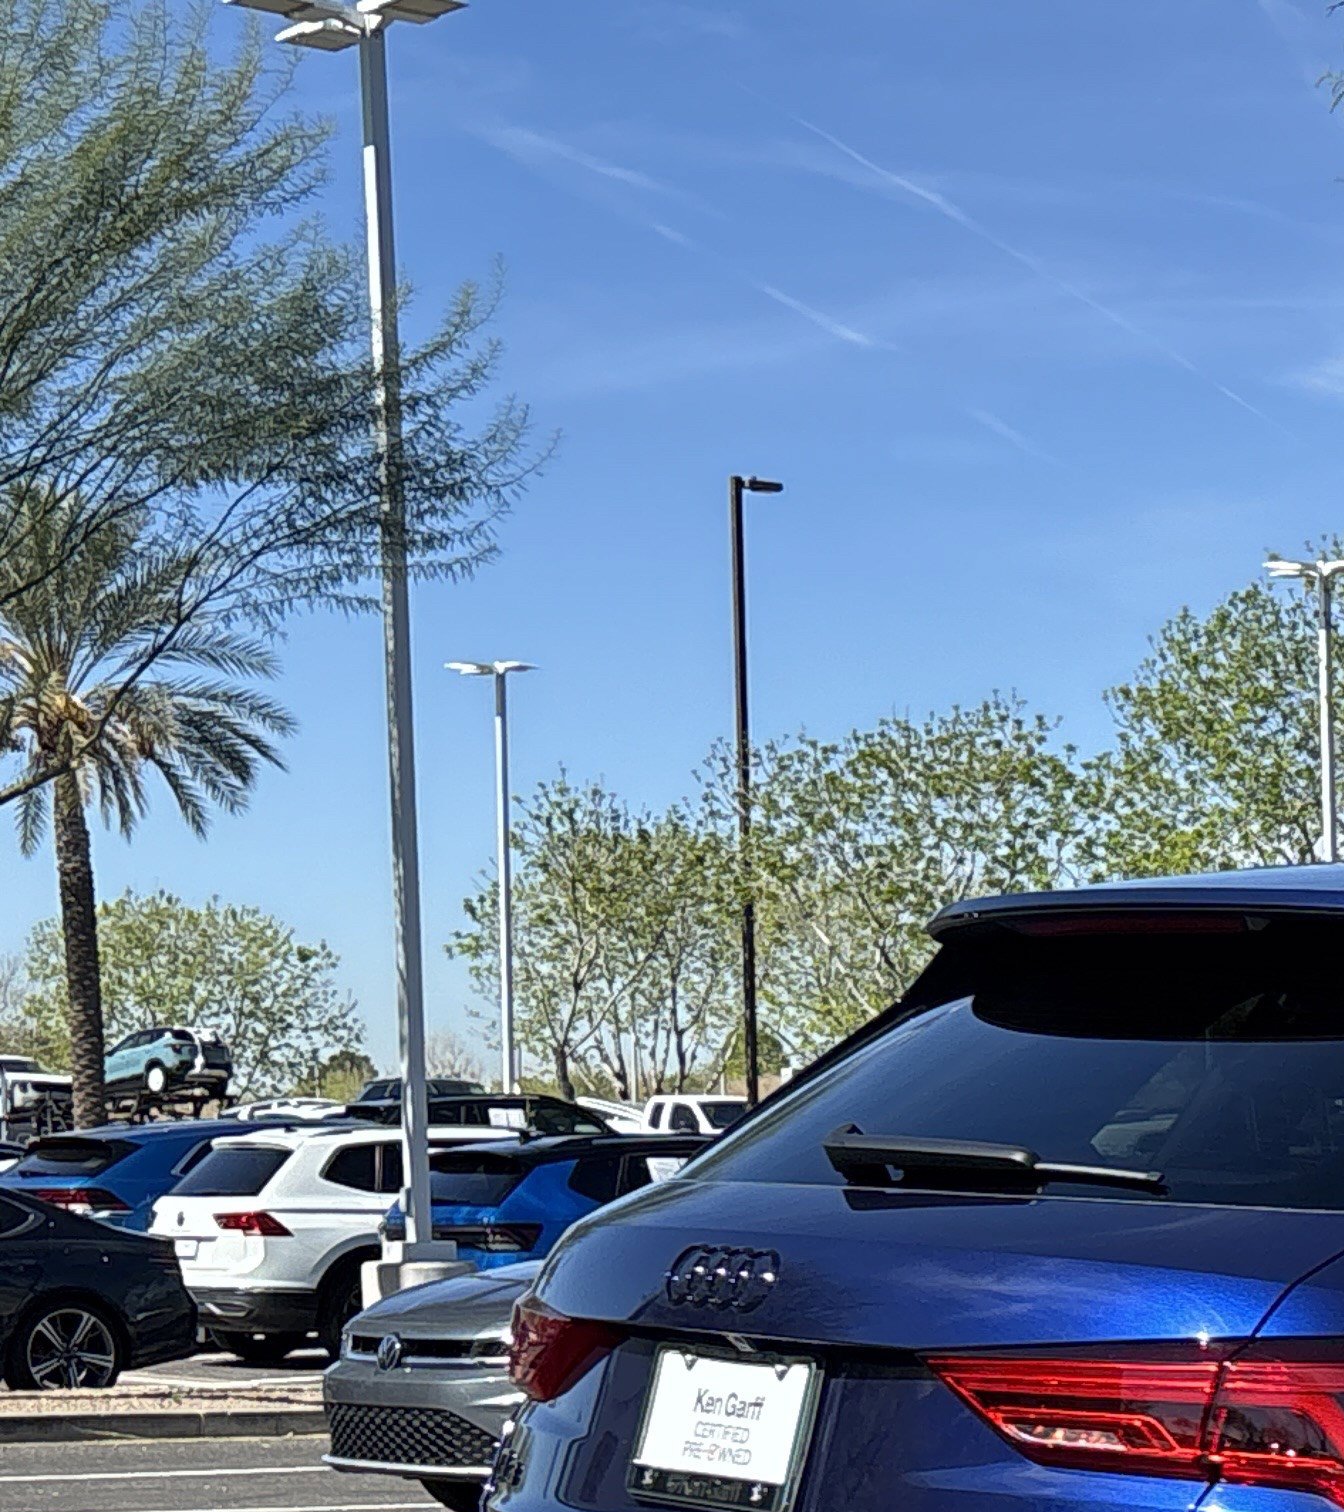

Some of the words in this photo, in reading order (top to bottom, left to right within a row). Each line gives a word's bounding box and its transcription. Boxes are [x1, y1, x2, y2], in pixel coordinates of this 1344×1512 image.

[692, 1387, 723, 1415] Ken
[725, 1391, 766, 1421] Garff
[694, 1421, 750, 1444] CERTIFIED
